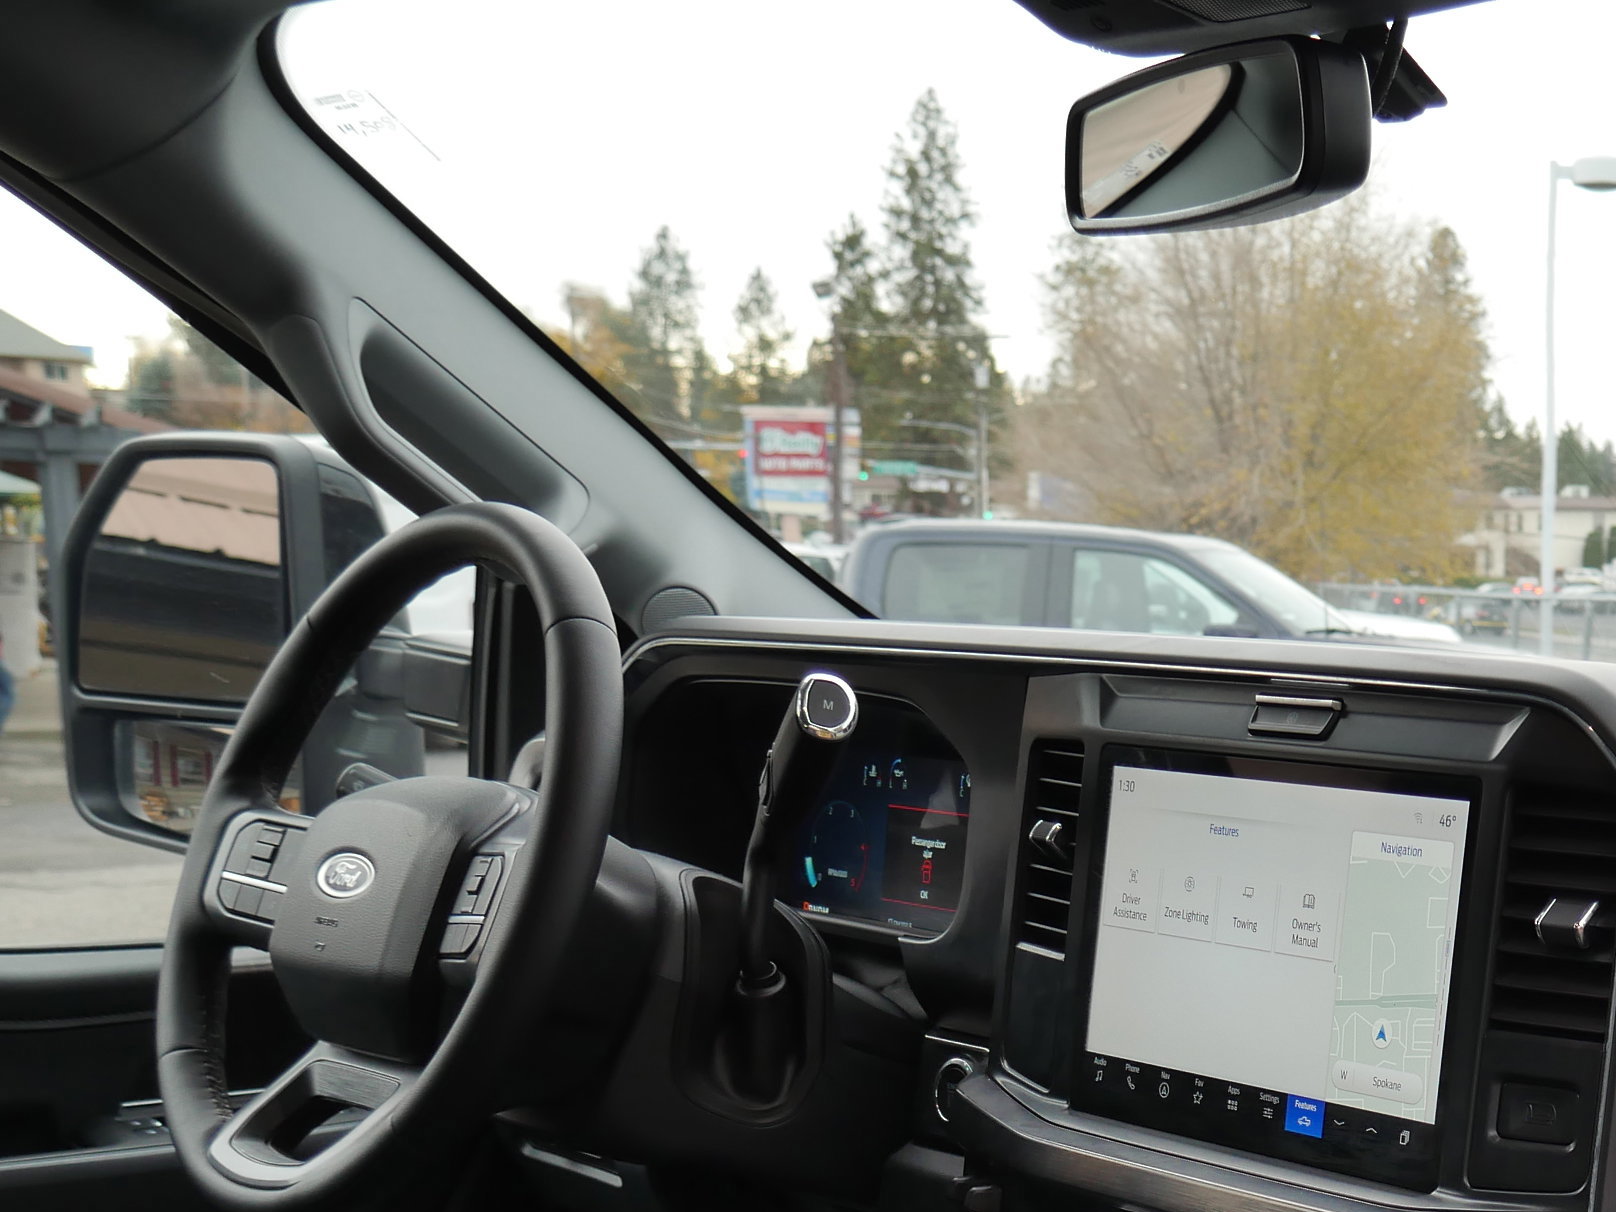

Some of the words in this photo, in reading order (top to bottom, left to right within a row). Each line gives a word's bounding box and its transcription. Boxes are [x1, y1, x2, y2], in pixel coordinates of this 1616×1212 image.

[1118, 780, 1136, 793] 1:30
[1438, 814, 1457, 828] 46°
[1209, 823, 1239, 838] Features
[1380, 842, 1423, 859] Navigation
[329, 862, 361, 887] Ford
[1121, 893, 1141, 906] Driver
[1113, 907, 1147, 922] Assistance
[1164, 907, 1182, 919] Zone
[1182, 909, 1209, 925] Lighting
[1233, 917, 1257, 933] Towing
[1291, 918, 1321, 933] Owner's
[1291, 935, 1318, 948] Manual
[1093, 1056, 1107, 1067] Audio
[1125, 1063, 1140, 1074] Phone
[1340, 1070, 1348, 1080] W
[1160, 1071, 1171, 1080] Nav
[1227, 1085, 1240, 1096] Apps
[1372, 1076, 1402, 1092] Spokane
[1259, 1091, 1280, 1104] Settings
[1294, 1099, 1317, 1112] Features
